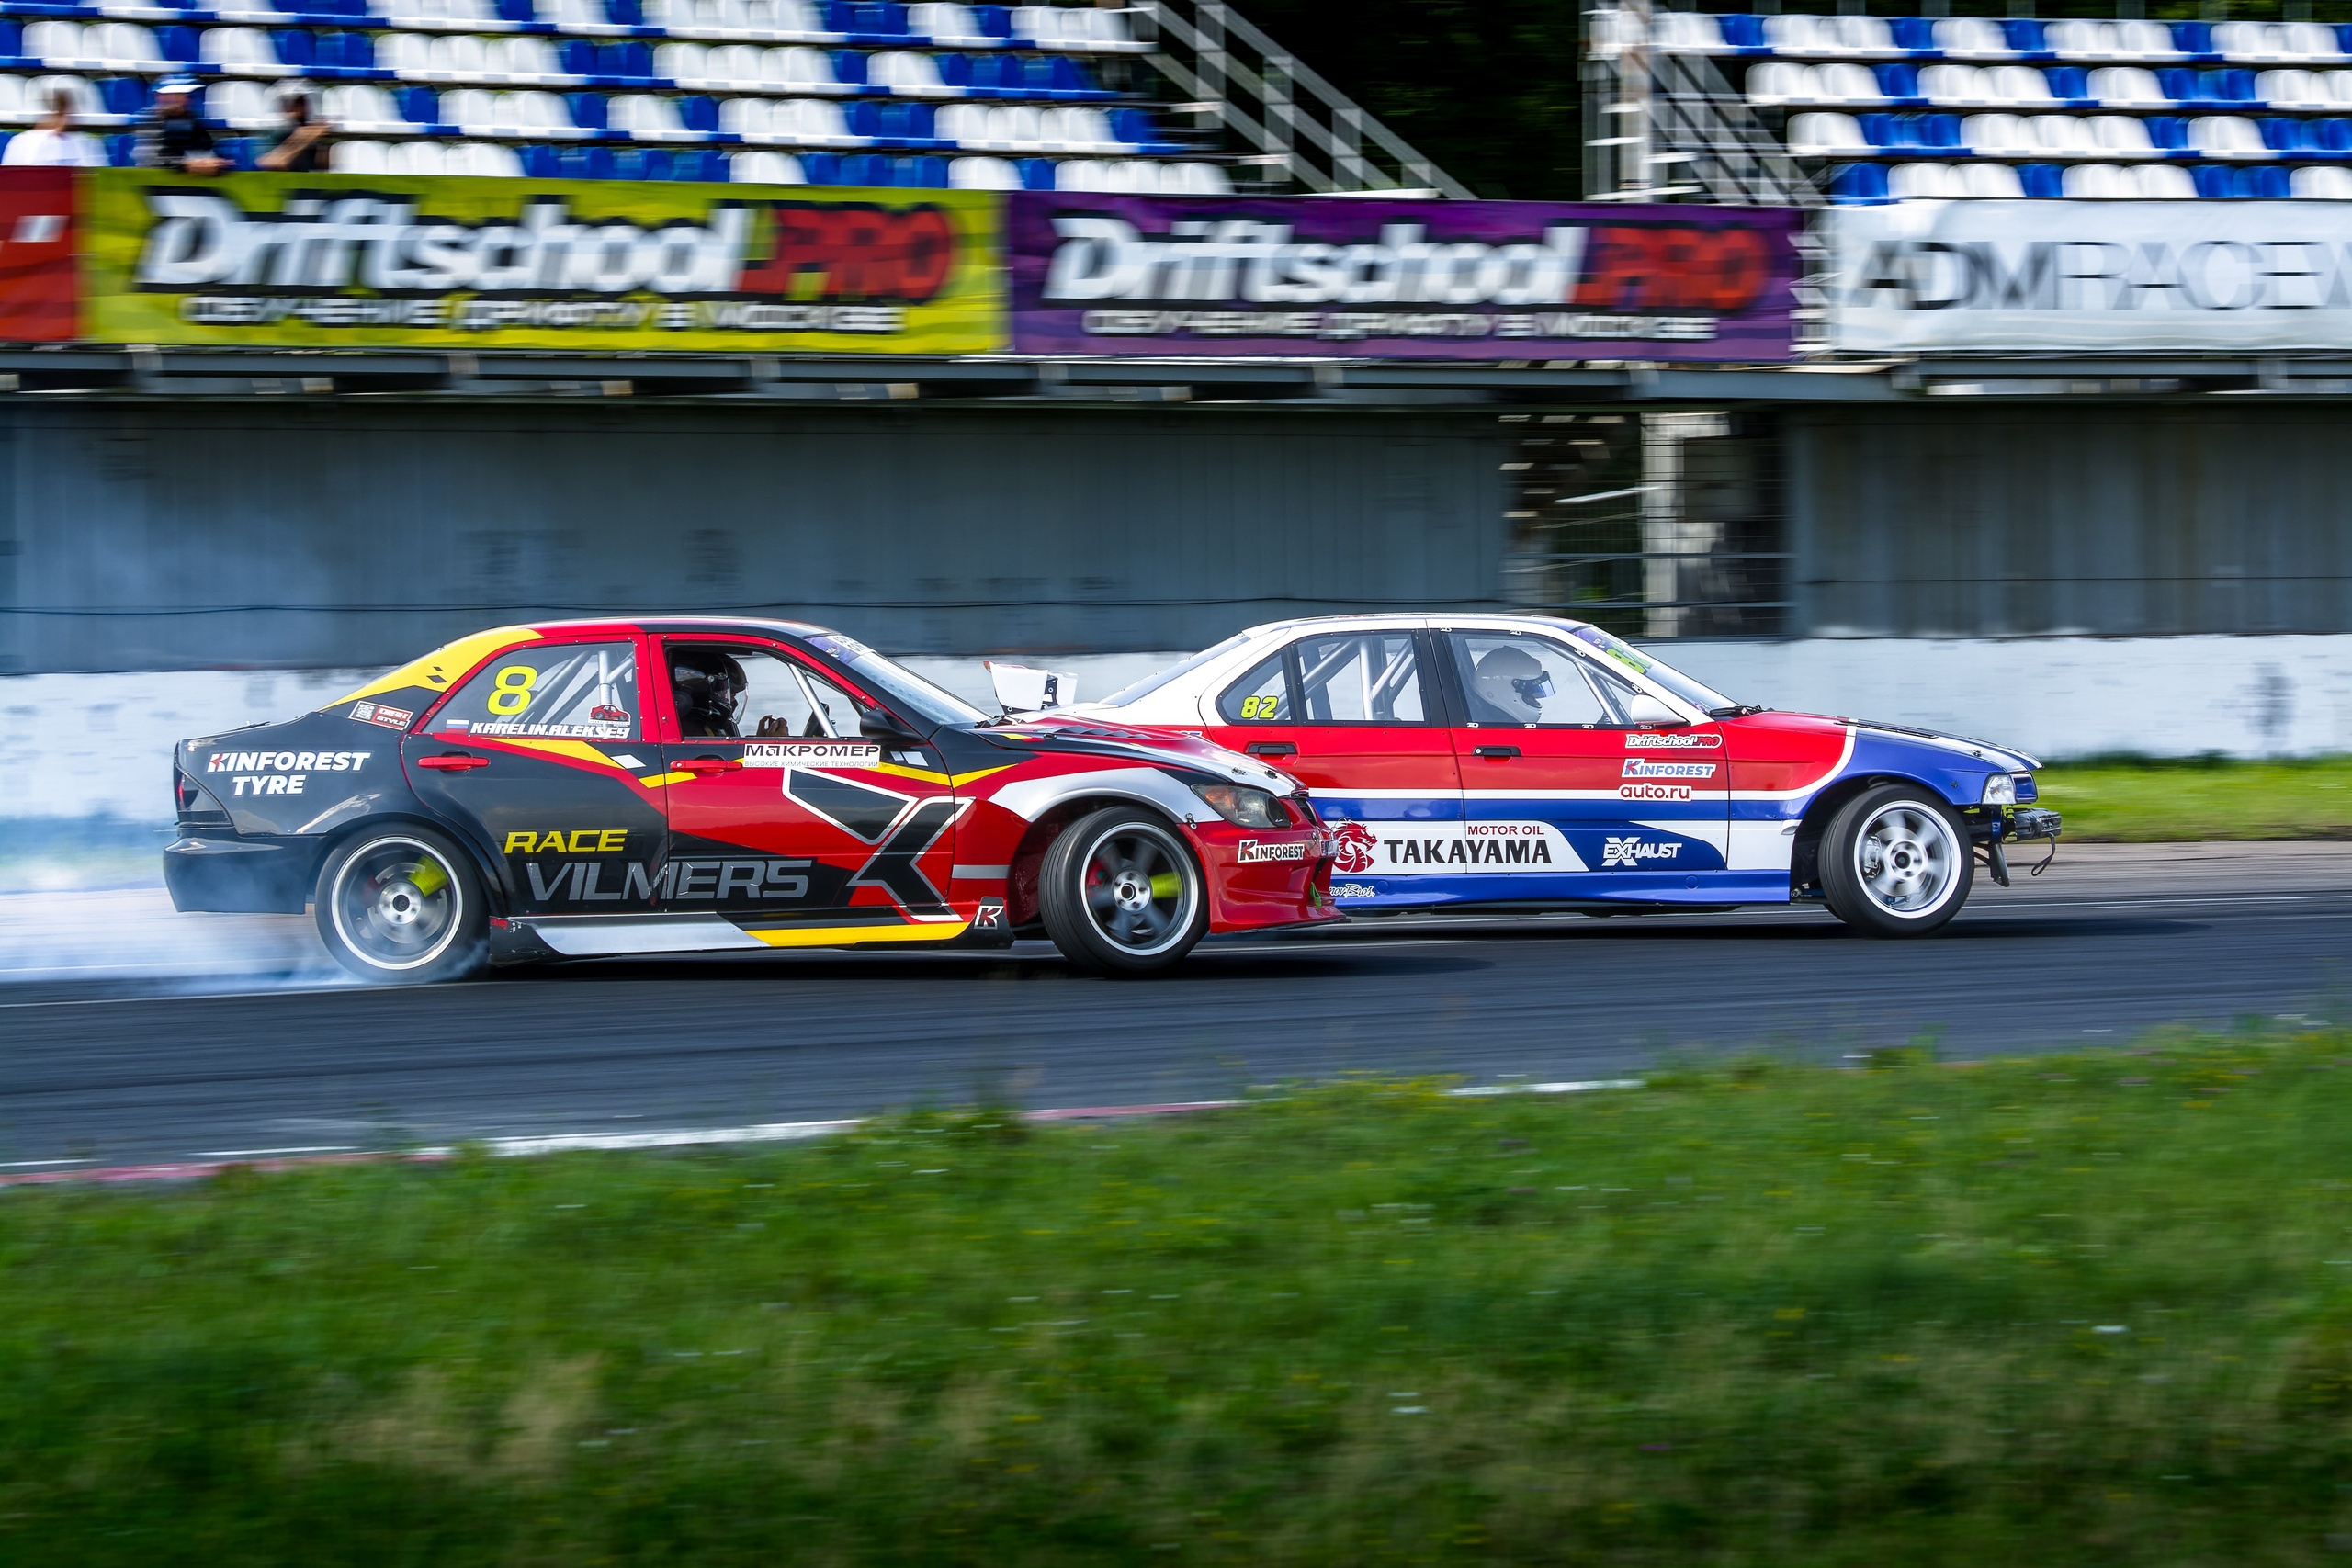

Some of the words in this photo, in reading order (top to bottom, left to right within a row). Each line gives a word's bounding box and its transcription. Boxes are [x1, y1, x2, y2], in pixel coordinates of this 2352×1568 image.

[487, 665, 537, 716] 8
[1240, 695, 1279, 719] 82
[376, 716, 406, 726] STYLE
[207, 751, 371, 773] KINFOREST
[232, 775, 305, 795] TYRE
[1620, 785, 1690, 799] auto.ru
[503, 829, 628, 854] RACE
[1467, 825, 1518, 836] MOTOR
[1522, 825, 1544, 835] OIL
[1239, 840, 1304, 861] KINFOREST
[1384, 840, 1552, 863] TAKAYAMA
[1601, 837, 1682, 866] EXHAUST
[526, 860, 812, 902] VILMERS
